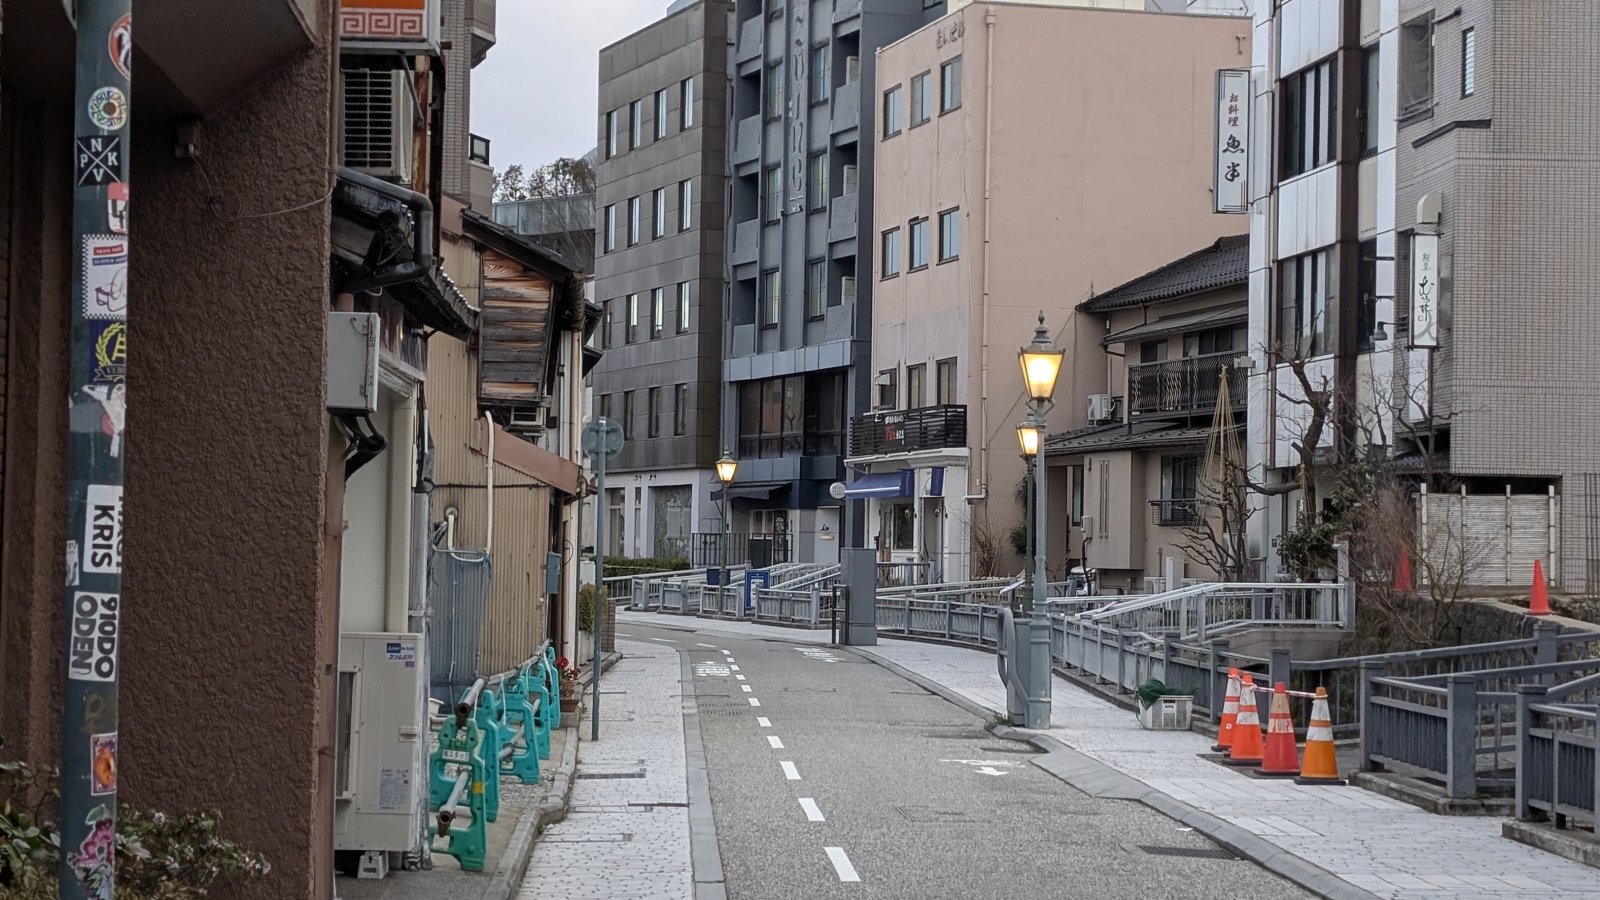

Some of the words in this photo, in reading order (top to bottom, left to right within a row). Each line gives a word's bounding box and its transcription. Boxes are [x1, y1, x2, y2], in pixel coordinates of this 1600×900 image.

[1227, 92, 1239, 127] お料理
[90, 504, 115, 568] KRIS
[72, 595, 98, 670] ODEN
[94, 596, 117, 679] 910DO
